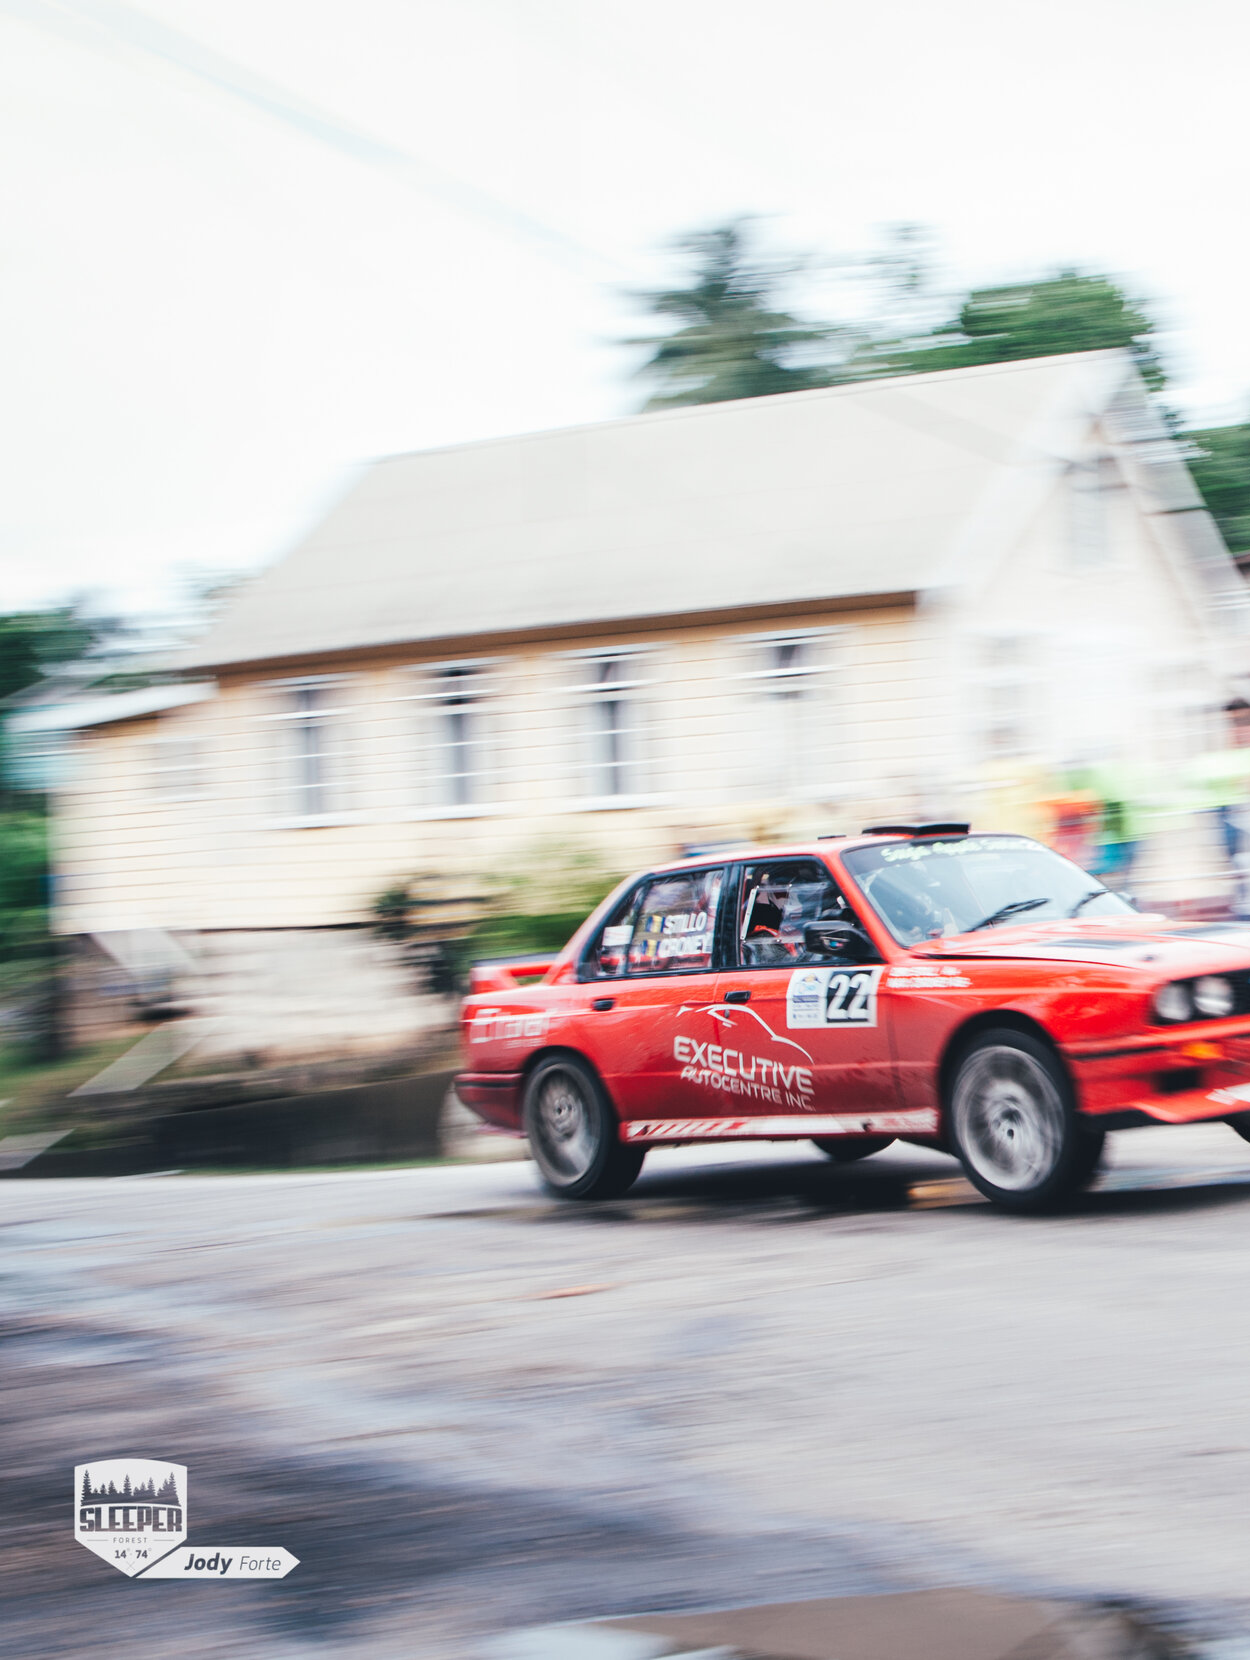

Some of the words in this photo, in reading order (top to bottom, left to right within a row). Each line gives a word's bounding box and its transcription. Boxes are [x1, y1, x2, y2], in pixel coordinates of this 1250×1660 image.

[827, 973, 872, 1019] 22
[673, 1035, 815, 1095] EXECUTIVE
[680, 1065, 783, 1105] AUTOCENTRE
